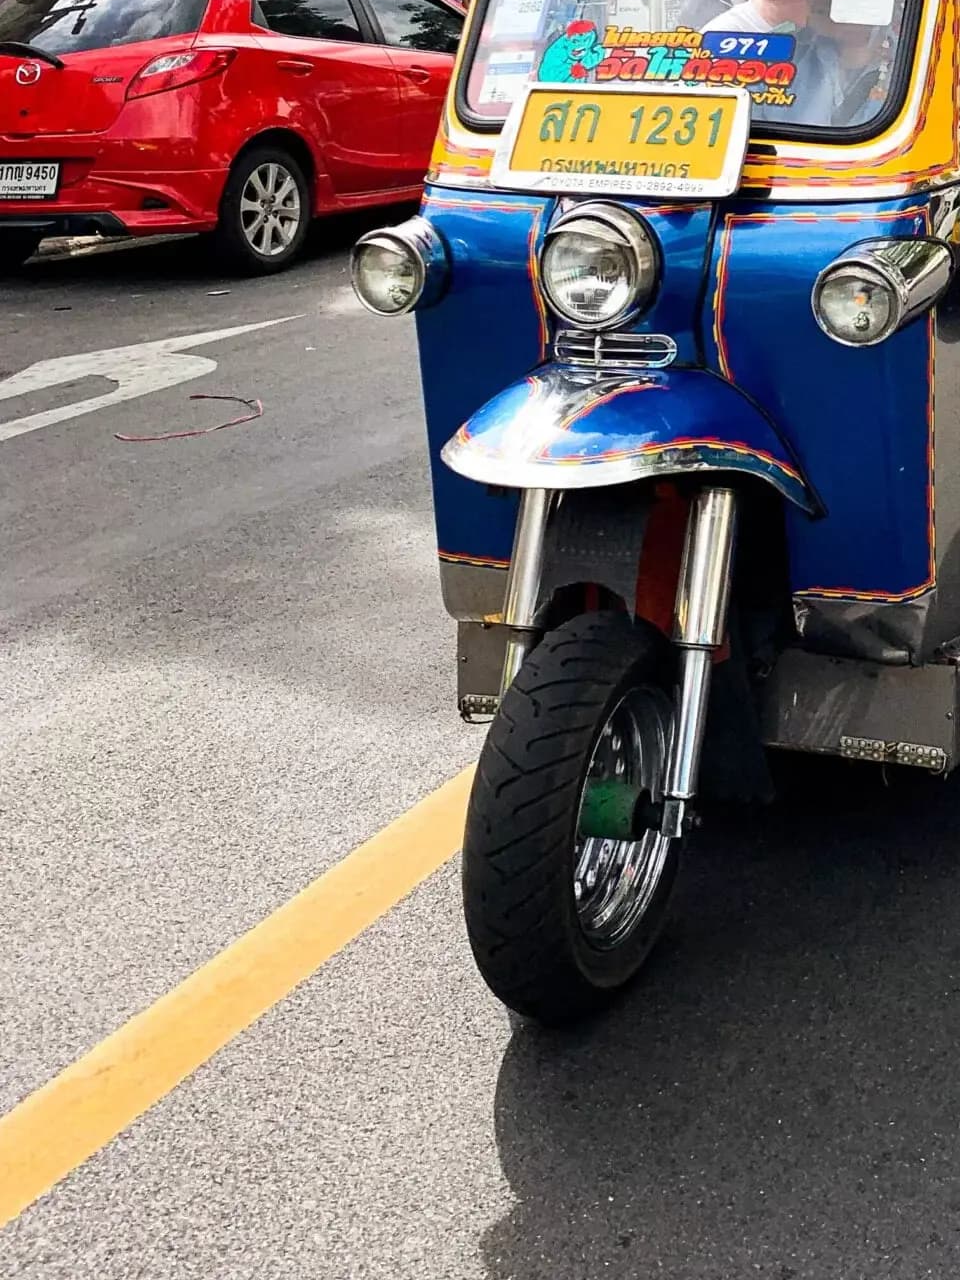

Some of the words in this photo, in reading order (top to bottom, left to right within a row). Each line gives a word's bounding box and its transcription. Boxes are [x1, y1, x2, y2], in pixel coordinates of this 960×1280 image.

[691, 47, 715, 59] No.
[719, 37, 769, 56] 971
[539, 99, 601, 143] สก
[629, 105, 724, 148] 1231
[25, 165, 57, 180] 9450
[539, 157, 691, 179] กรงเทพมหานคร
